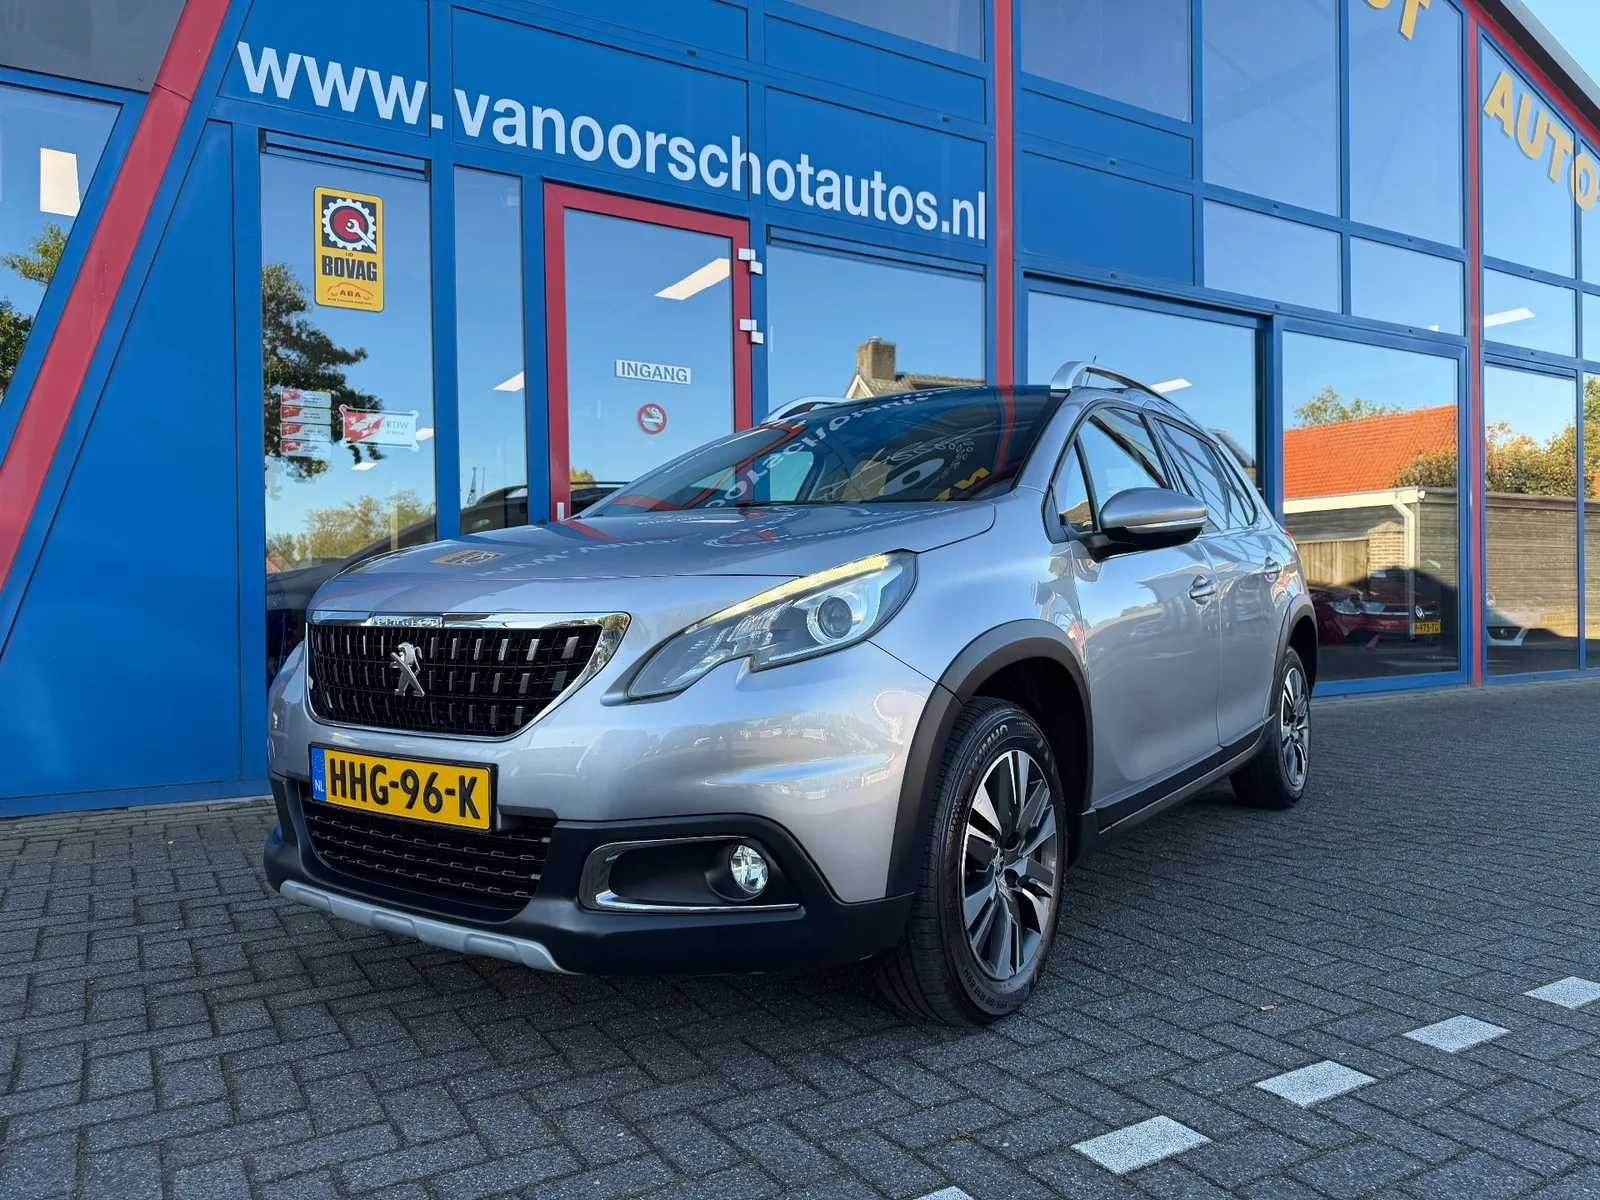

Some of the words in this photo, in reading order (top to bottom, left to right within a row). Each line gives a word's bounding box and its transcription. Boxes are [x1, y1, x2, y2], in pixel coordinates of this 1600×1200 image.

[237, 41, 986, 240] www.vanoorschotautos.nl
[321, 254, 378, 282] BOVAG
[339, 289, 362, 298] ABA
[621, 361, 688, 383] INGANG
[386, 420, 410, 429] RDW
[314, 779, 325, 792] NL
[329, 758, 481, 820] HHG-96-K
